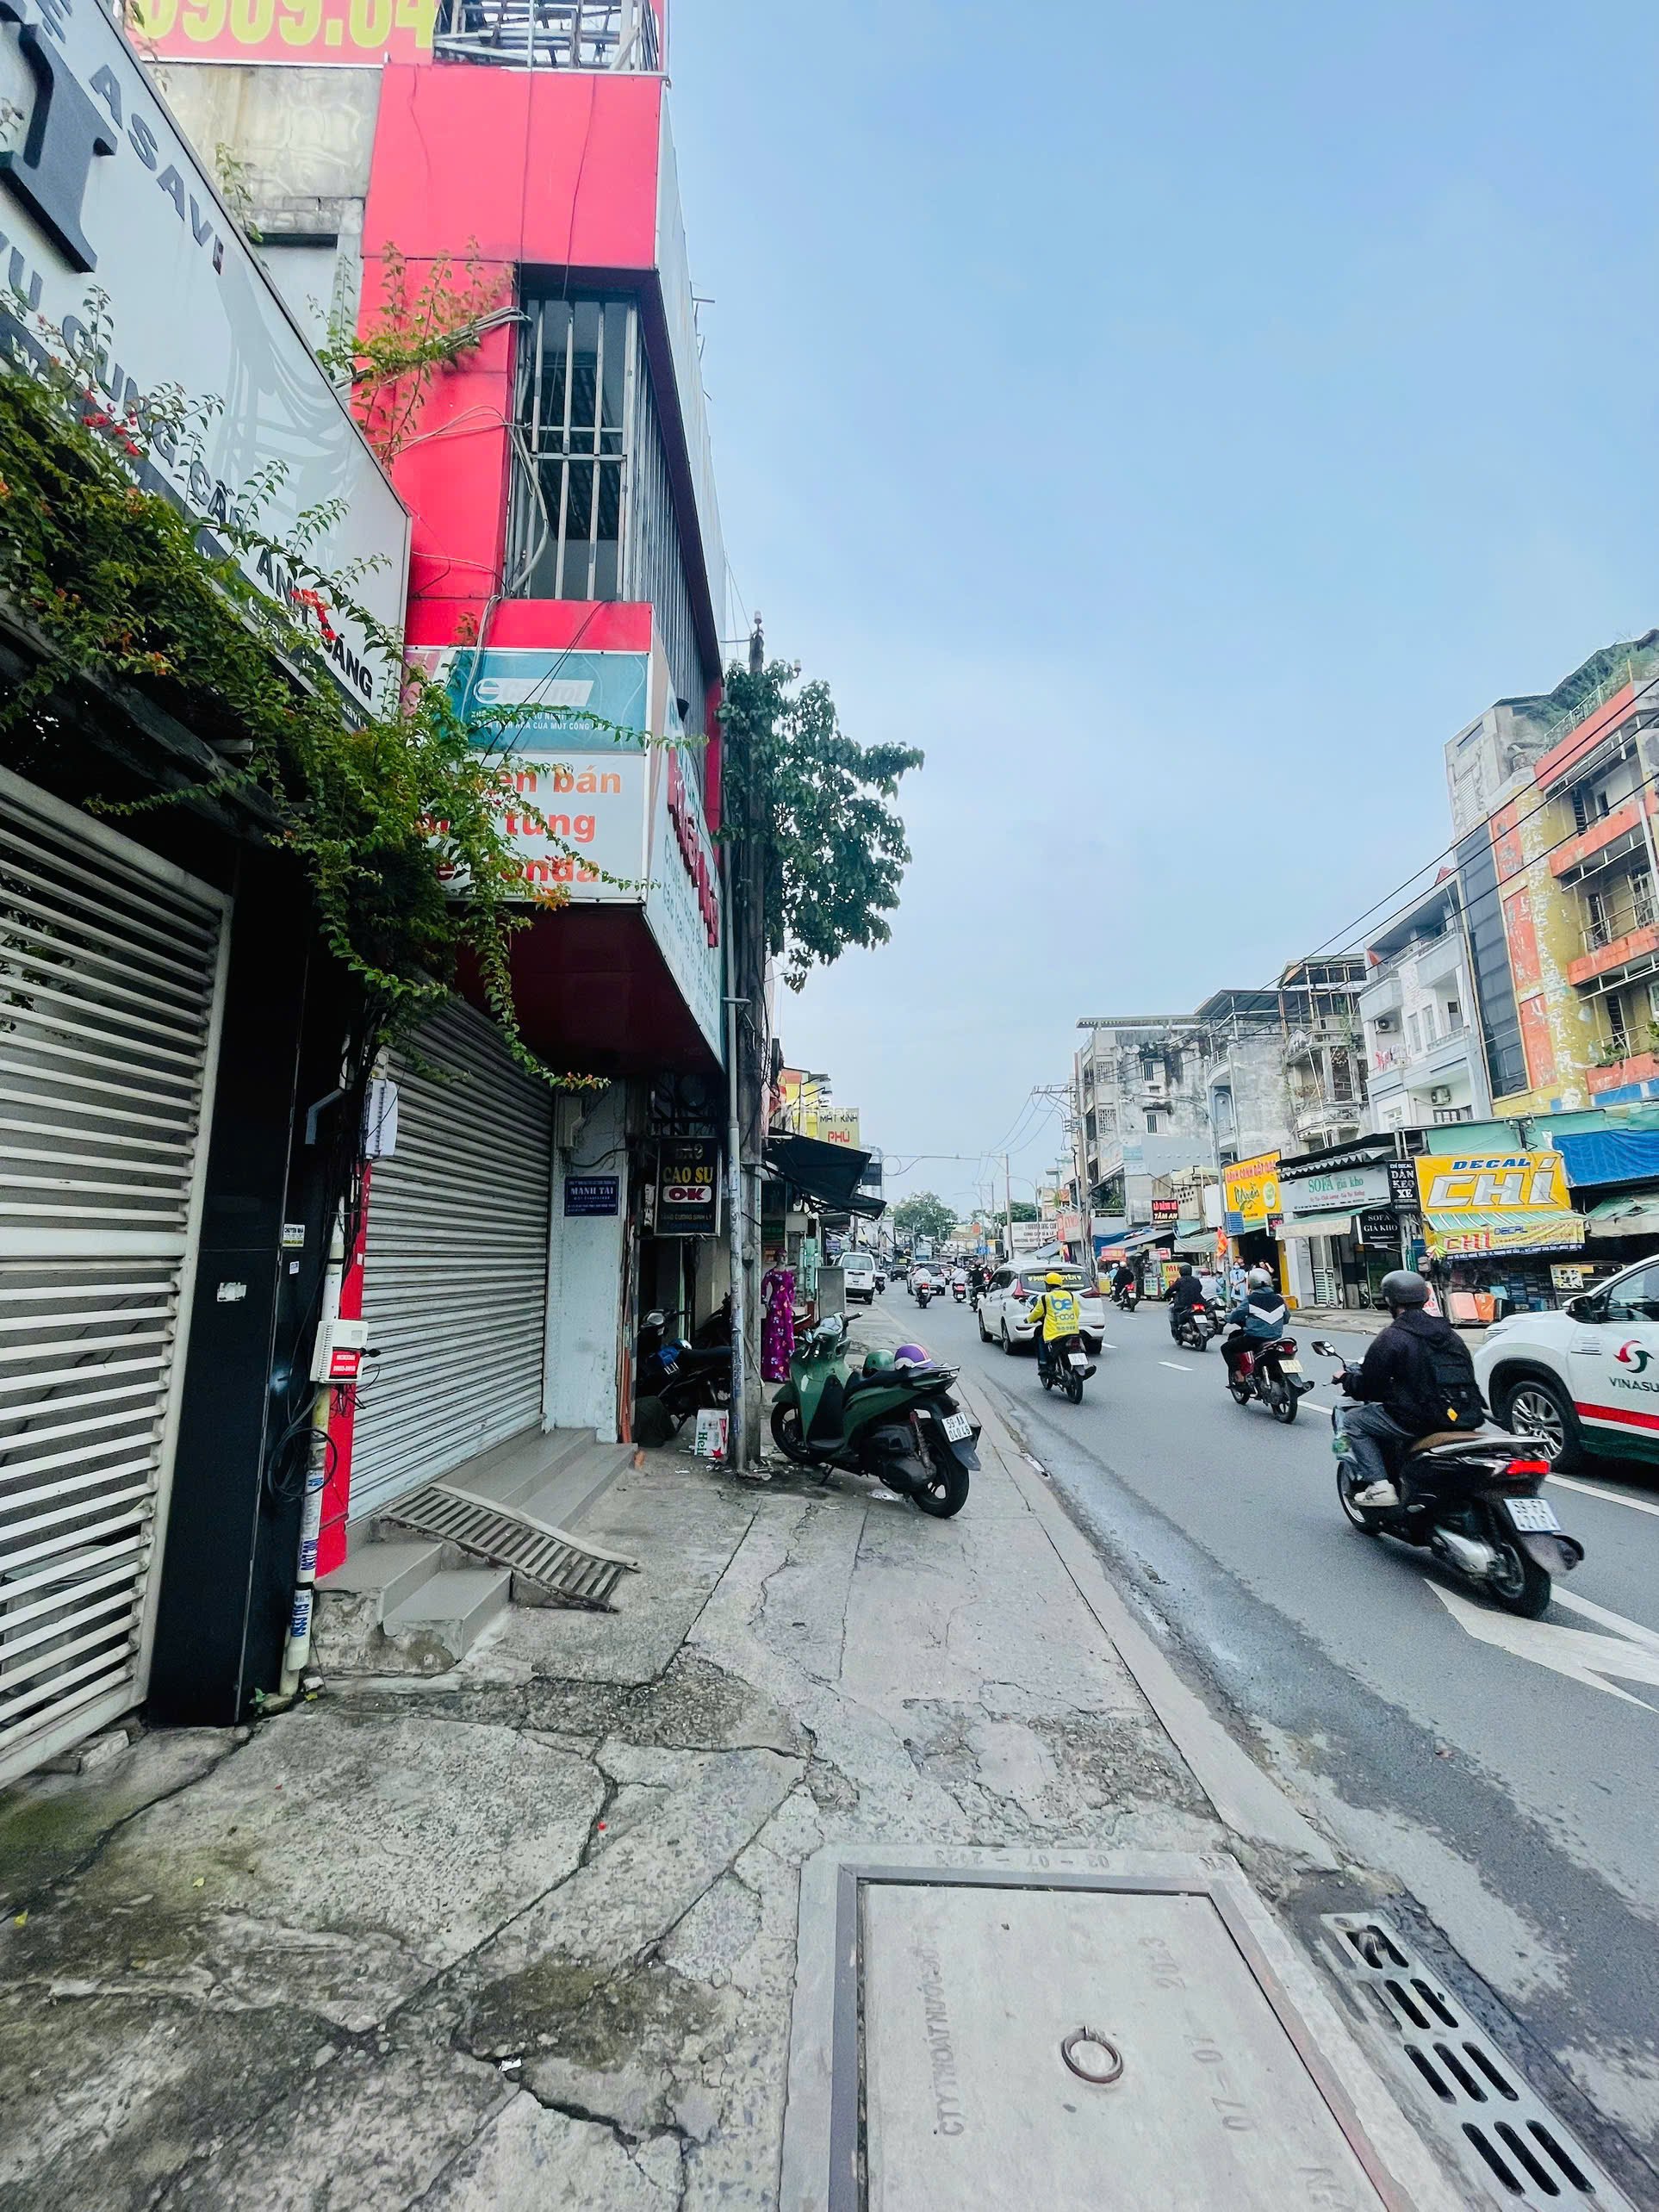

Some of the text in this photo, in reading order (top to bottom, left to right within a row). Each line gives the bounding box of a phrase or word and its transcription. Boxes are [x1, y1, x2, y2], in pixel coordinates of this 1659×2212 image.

[554, 765, 621, 794] bán
[1452, 1157, 1531, 1171] DECAL
[662, 1166, 713, 1184] CAO SU
[1426, 1157, 1558, 1209] CHÍ
[1308, 1174, 1334, 1193] SOFA
[1350, 1175, 1364, 1188] kho
[668, 1187, 705, 1201] OK
[1396, 1189, 1414, 1198] XE
[1380, 1224, 1398, 1233] KHO
[1494, 1226, 1529, 1236] DECAL
[1444, 1227, 1491, 1251] CHÍ
